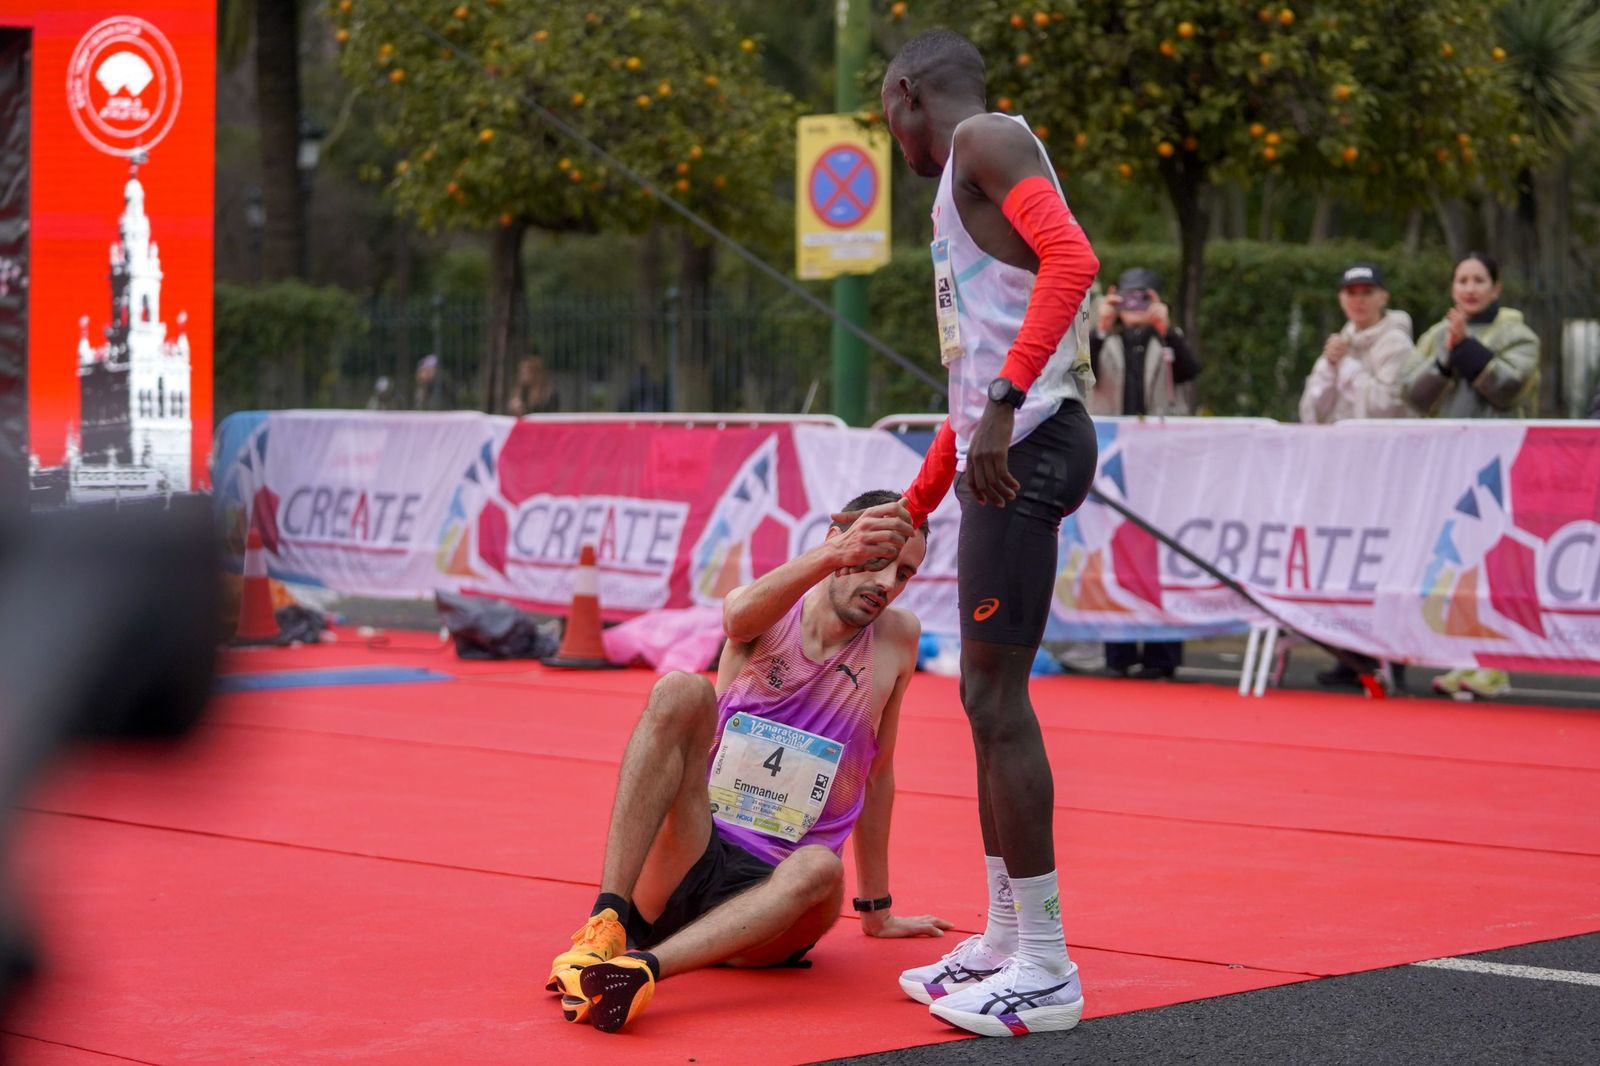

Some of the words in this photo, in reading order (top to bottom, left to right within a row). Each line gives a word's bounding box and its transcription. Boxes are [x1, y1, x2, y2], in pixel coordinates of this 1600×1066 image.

[283, 486, 421, 542] CREATE
[513, 503, 678, 565] CREATE
[1166, 518, 1390, 592] CREATE
[762, 746, 785, 777] 4
[733, 778, 789, 804] Emmanuel
